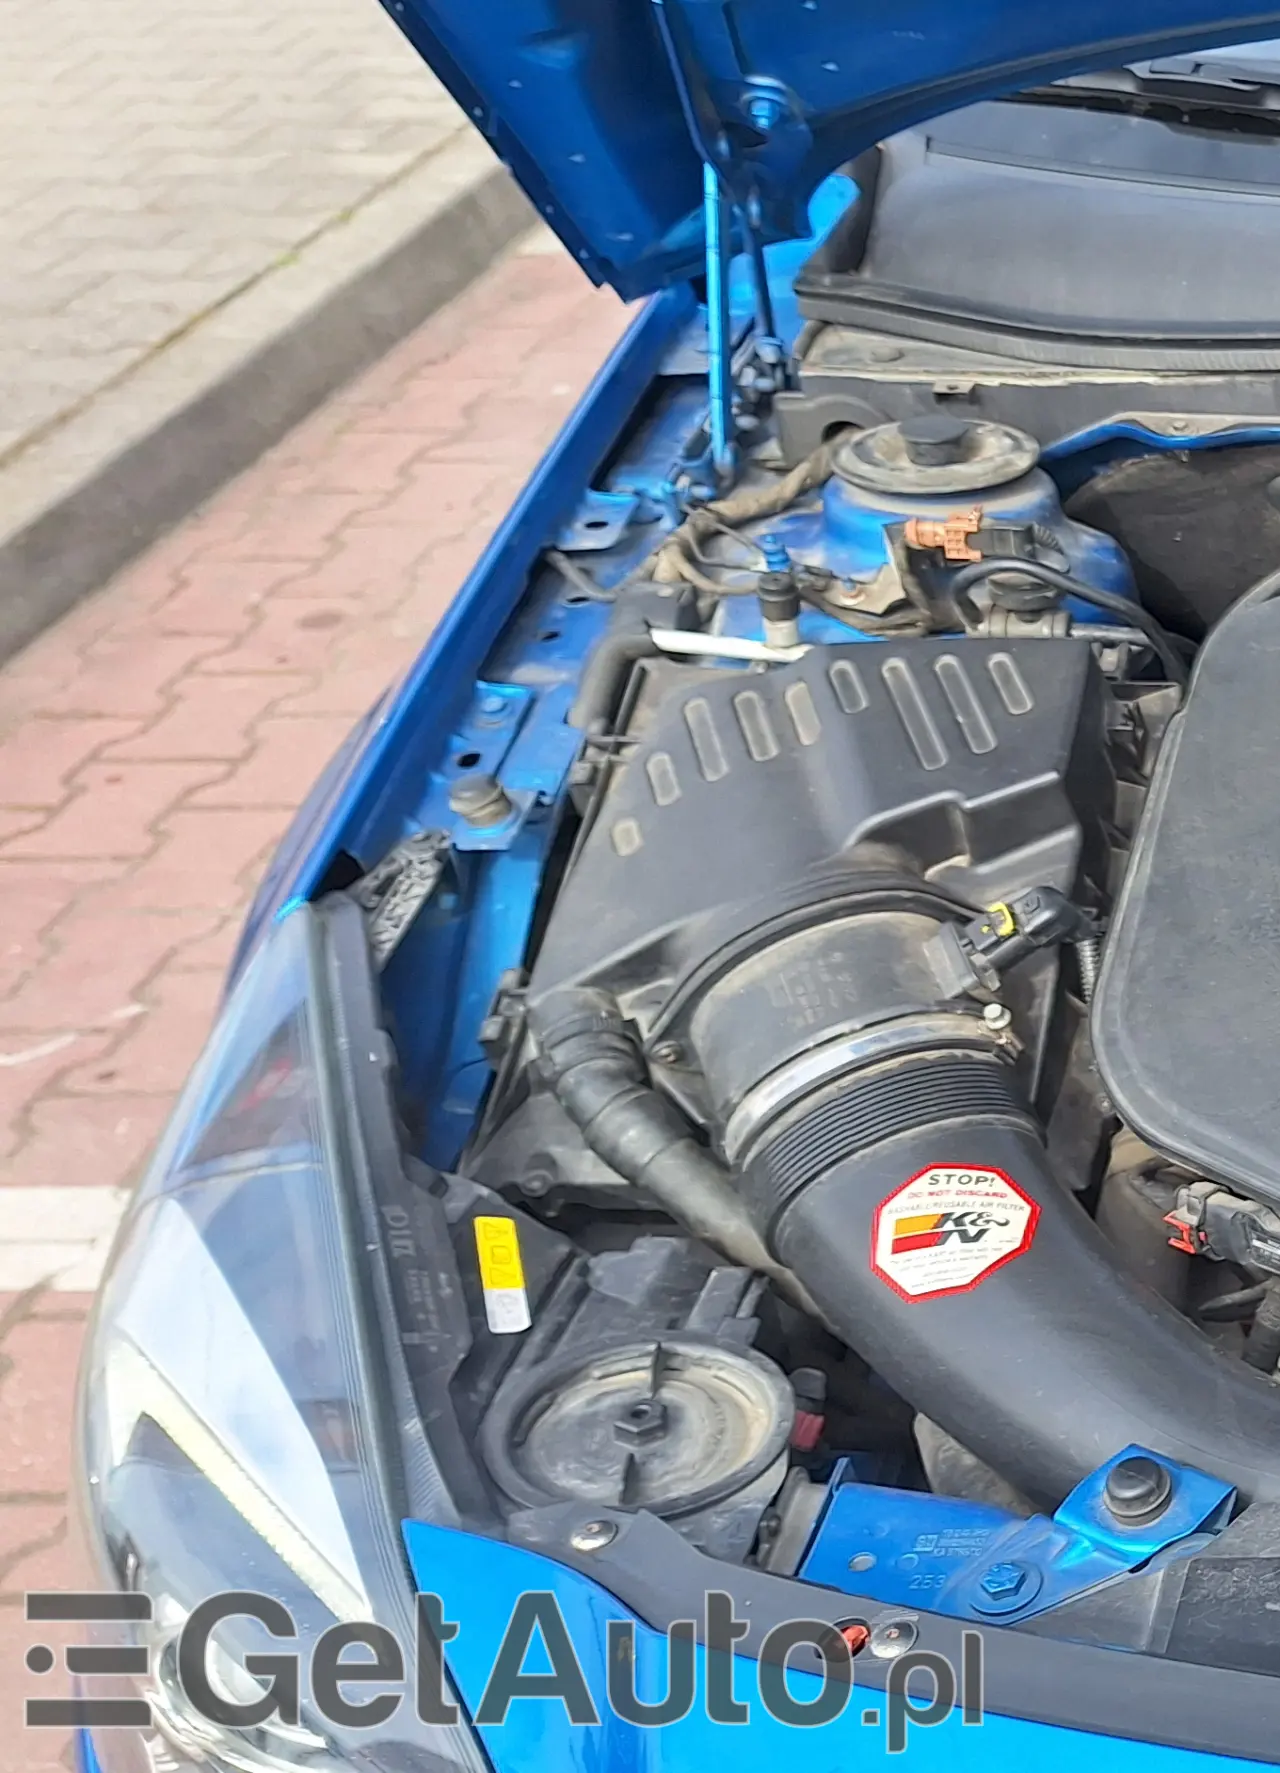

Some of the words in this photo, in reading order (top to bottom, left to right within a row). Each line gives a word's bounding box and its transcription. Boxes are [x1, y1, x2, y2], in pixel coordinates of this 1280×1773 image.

[928, 1173, 996, 1187] STOP!
[927, 1189, 951, 1197] NOT
[955, 1189, 1008, 1199] DISCARD
[979, 1201, 994, 1209] AIR
[996, 1201, 1025, 1212] FILTER
